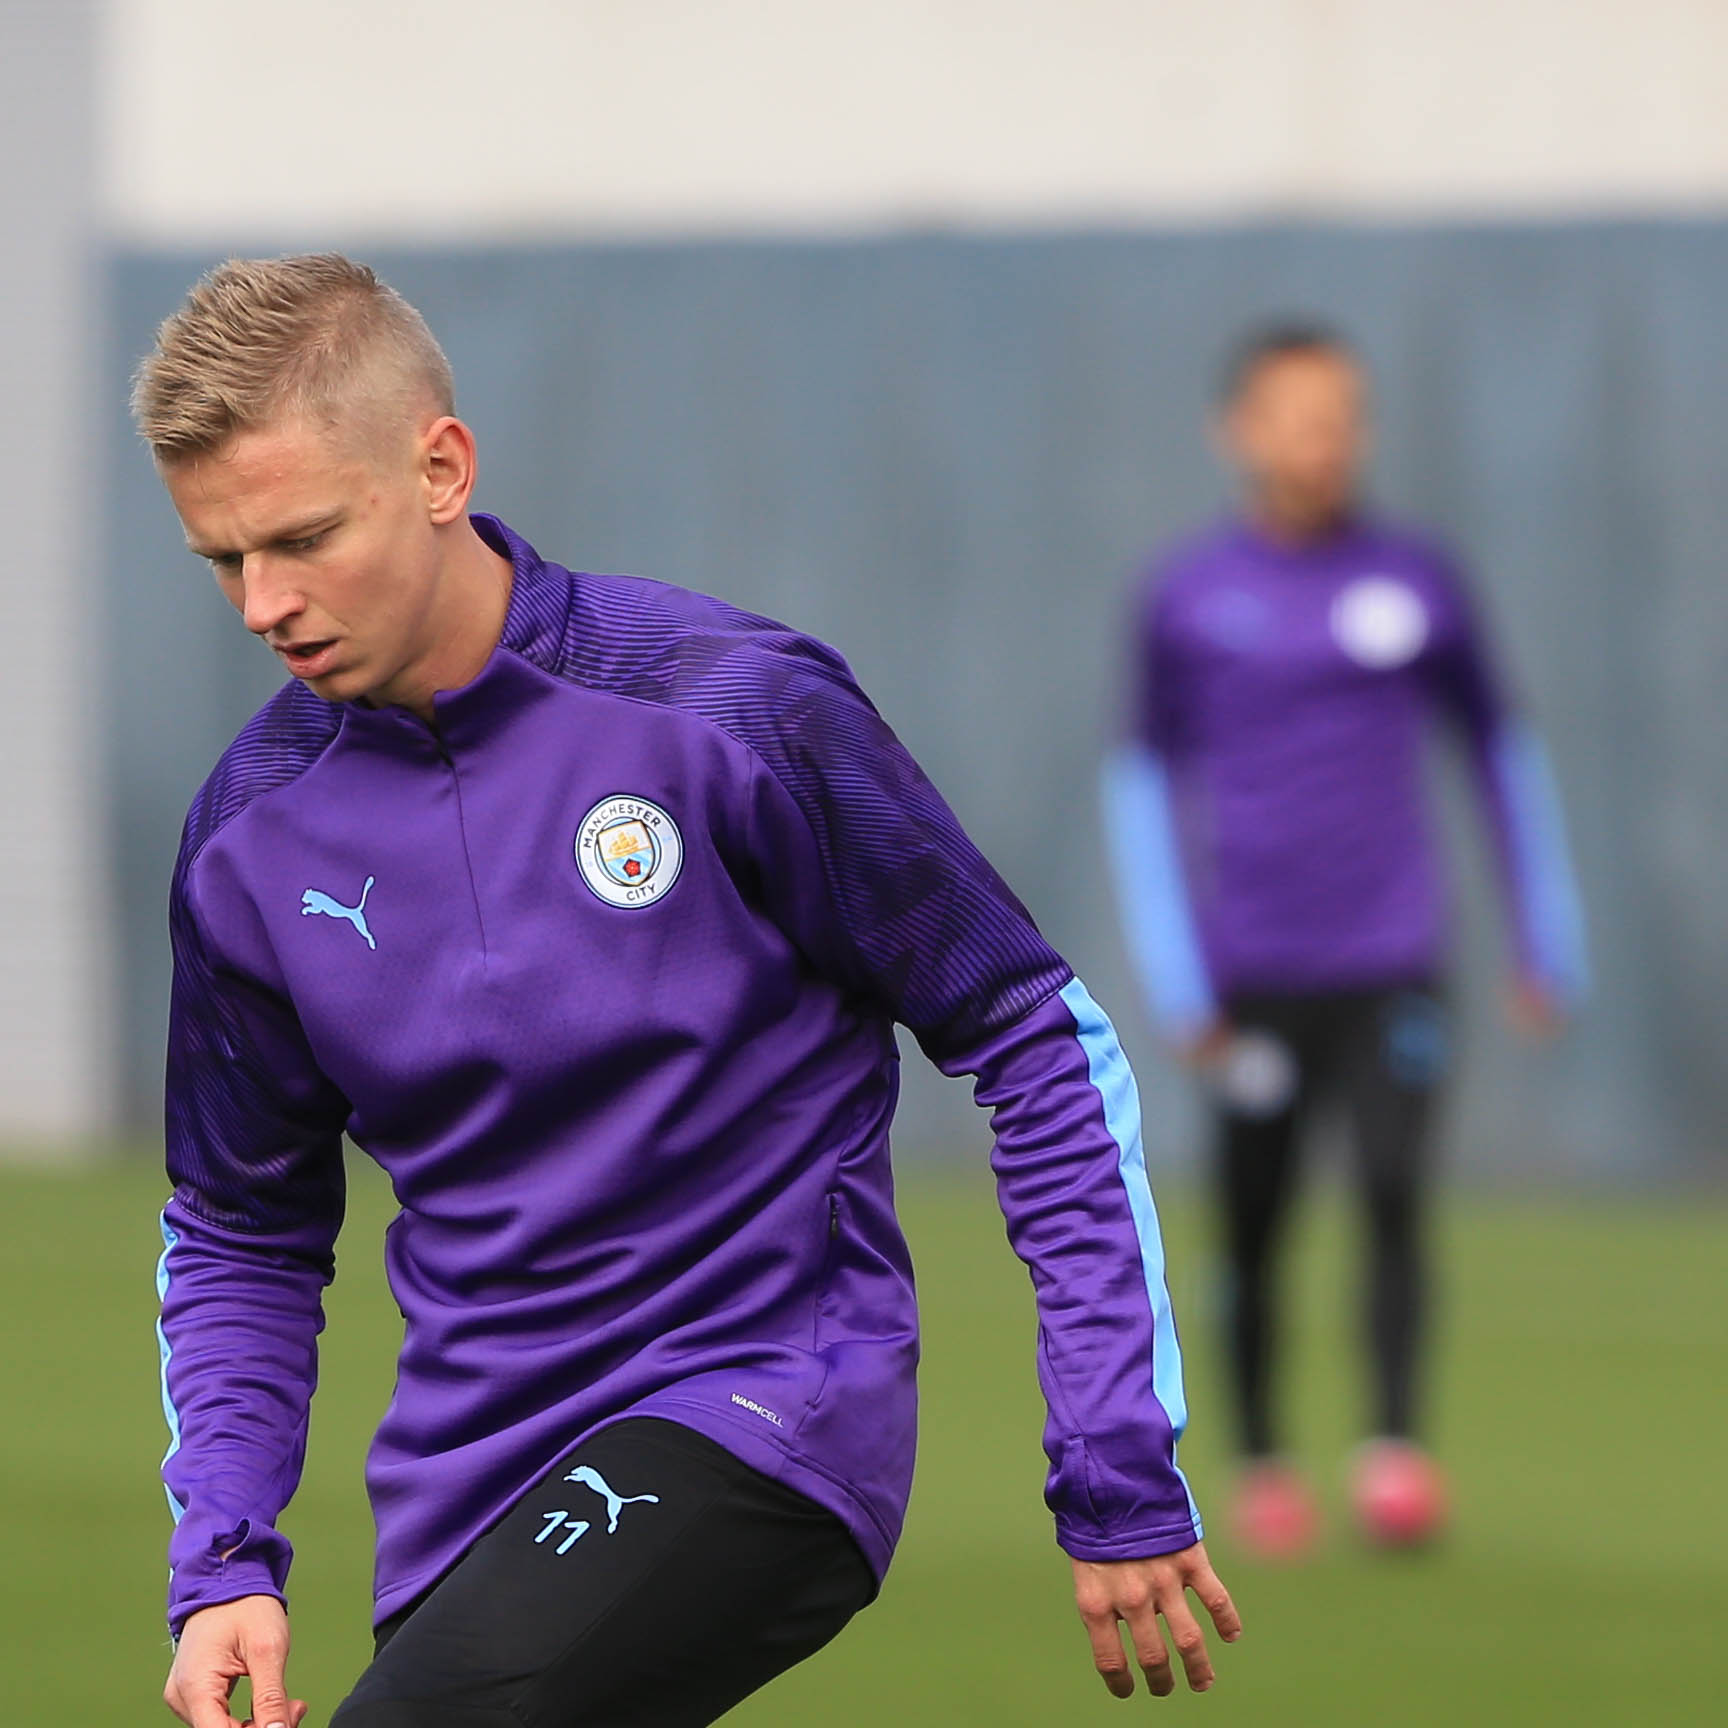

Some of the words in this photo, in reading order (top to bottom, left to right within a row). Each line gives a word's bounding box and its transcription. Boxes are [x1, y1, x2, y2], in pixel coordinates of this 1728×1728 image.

[583, 803, 661, 849] MANCHESTER
[626, 883, 656, 901] CITY
[732, 1393, 784, 1429] WARMCELL
